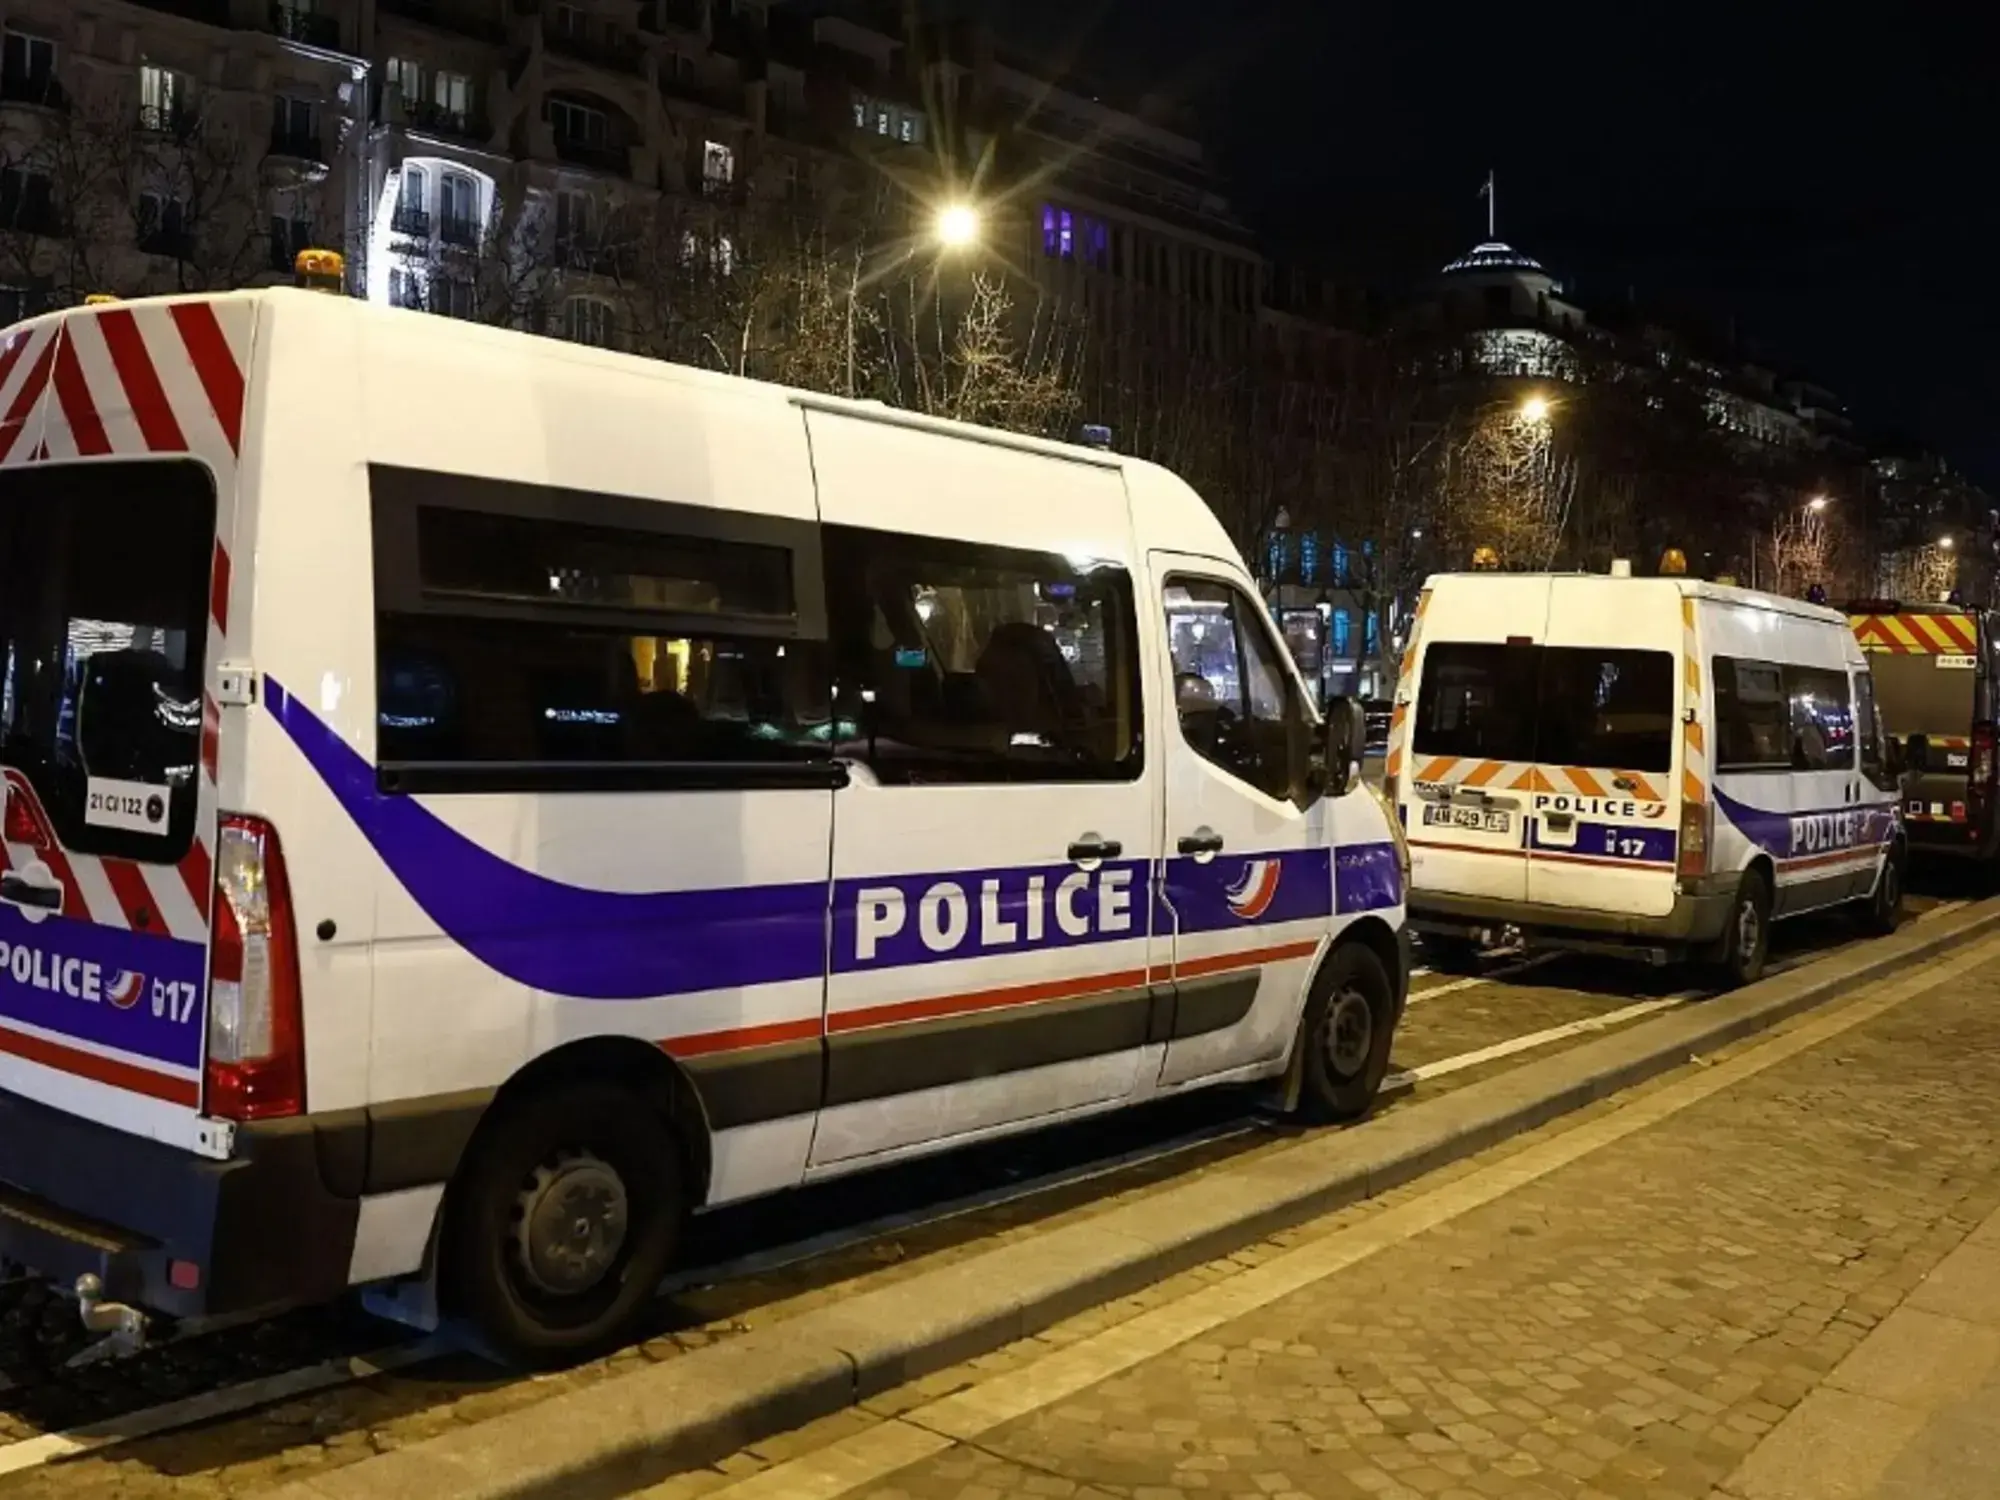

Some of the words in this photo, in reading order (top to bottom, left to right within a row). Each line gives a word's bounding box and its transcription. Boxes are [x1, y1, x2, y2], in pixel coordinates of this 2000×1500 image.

[122, 796, 142, 816] 122
[1535, 795, 1634, 817] POLICE
[1620, 838, 1645, 856] 17
[1790, 811, 1852, 852] POLICE
[855, 869, 1133, 960] POLICE
[167, 980, 196, 1024] 17
